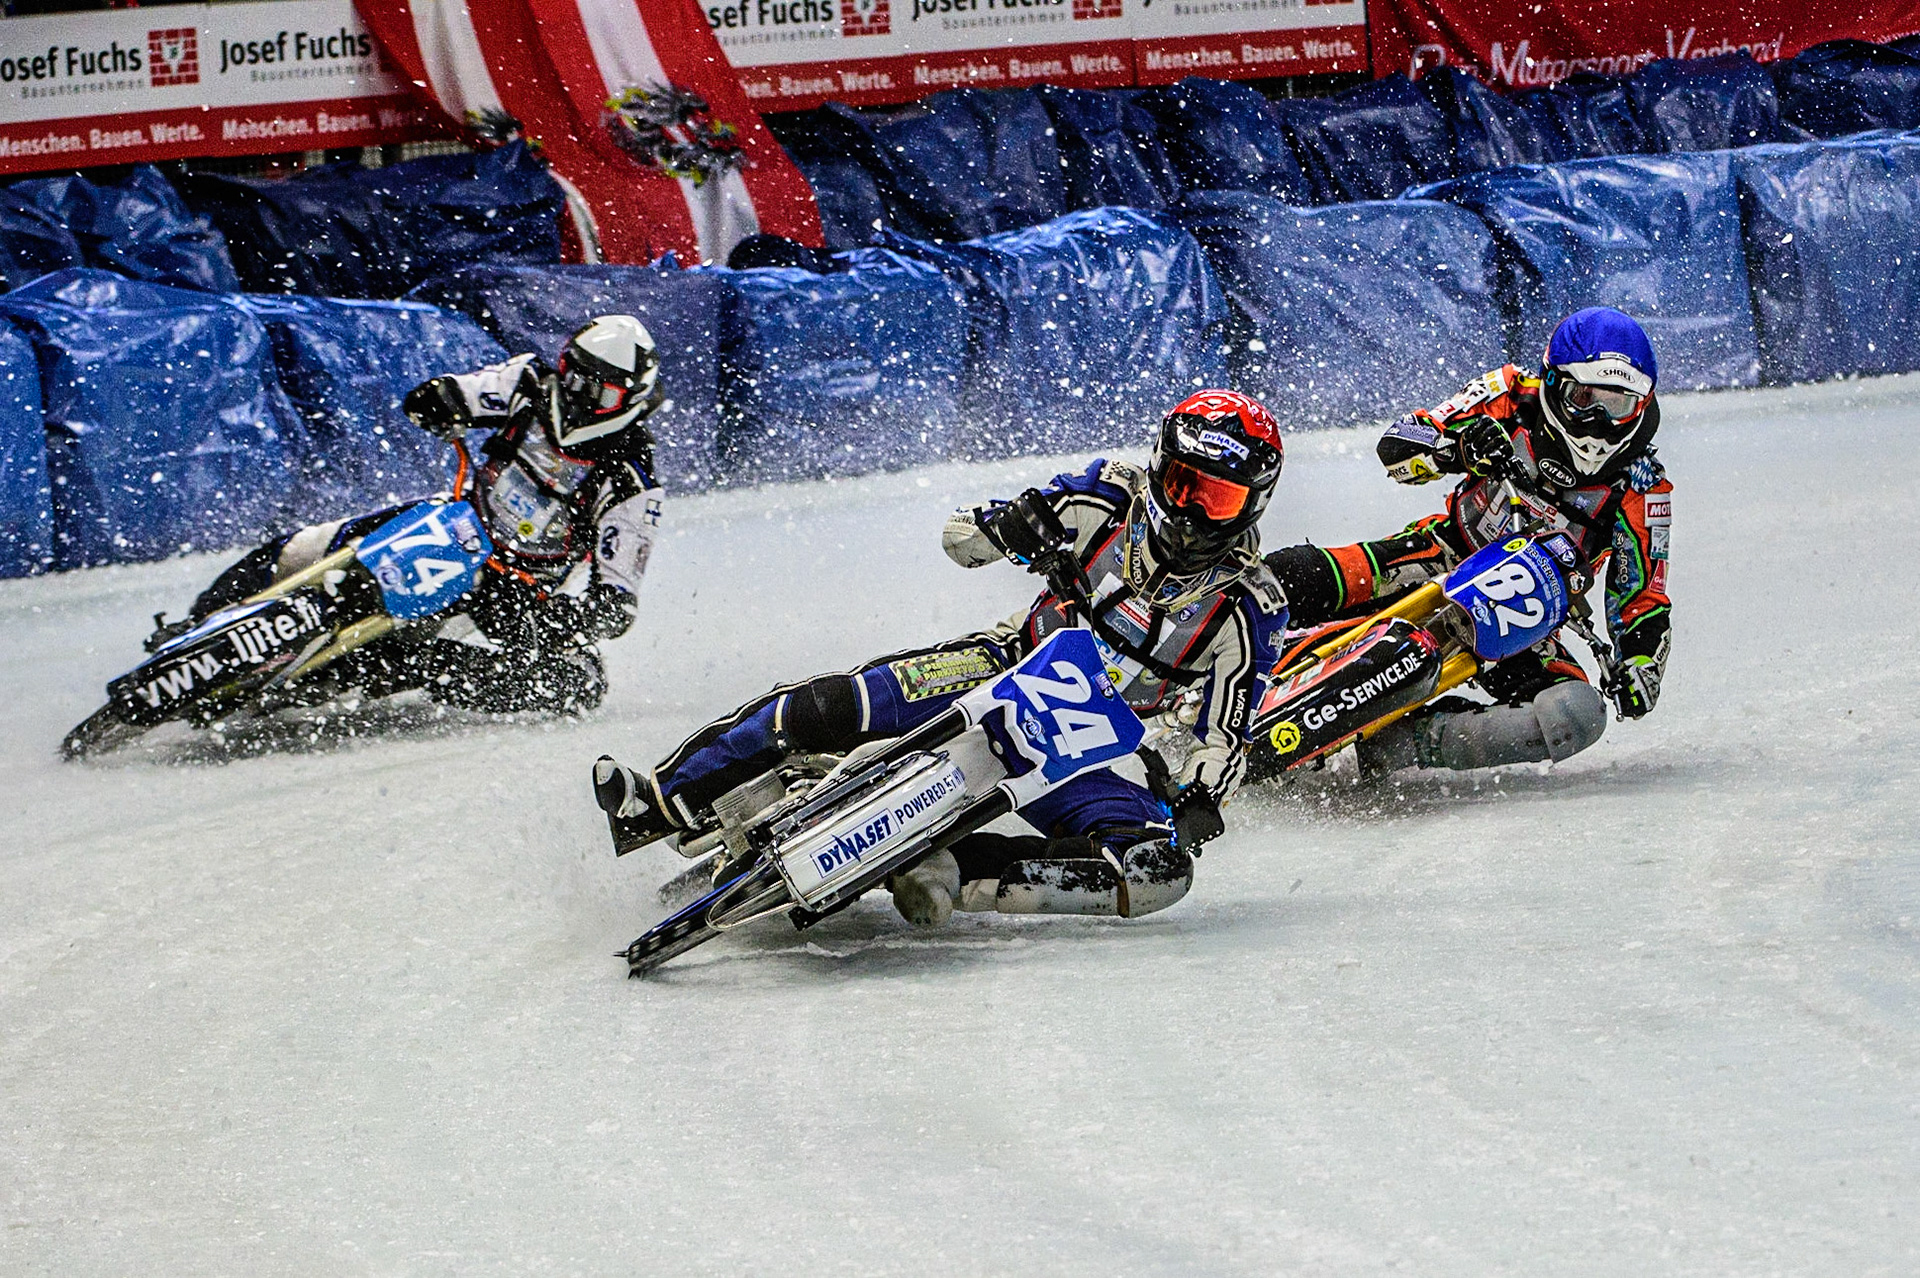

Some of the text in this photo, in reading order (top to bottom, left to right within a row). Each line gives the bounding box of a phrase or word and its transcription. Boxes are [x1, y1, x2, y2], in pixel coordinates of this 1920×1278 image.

[708, 0, 834, 30] sef Fuchs
[0, 40, 142, 82] osef Fuchs
[220, 27, 372, 74] Josef Fuchs
[1009, 58, 1068, 79] Bauen.
[1070, 54, 1126, 75] Werte.
[1242, 43, 1300, 64] Bauen.
[1302, 39, 1358, 59] Werte.
[779, 76, 840, 97] Bauen.
[840, 71, 897, 93] Werte.
[89, 128, 149, 151] Bauen.
[150, 122, 206, 145] Werte.
[316, 111, 376, 134] Bauen.
[1602, 368, 1634, 383] SHOEI
[1203, 432, 1246, 455] DYNASET
[1617, 548, 1629, 584] WACO
[1473, 562, 1545, 637] 82
[1303, 651, 1421, 730] Ge-SERVICE.DE
[1011, 660, 1119, 760] 24
[1232, 688, 1248, 728] WACO
[816, 814, 893, 874] DYNASET
[894, 781, 948, 826] POWERED
